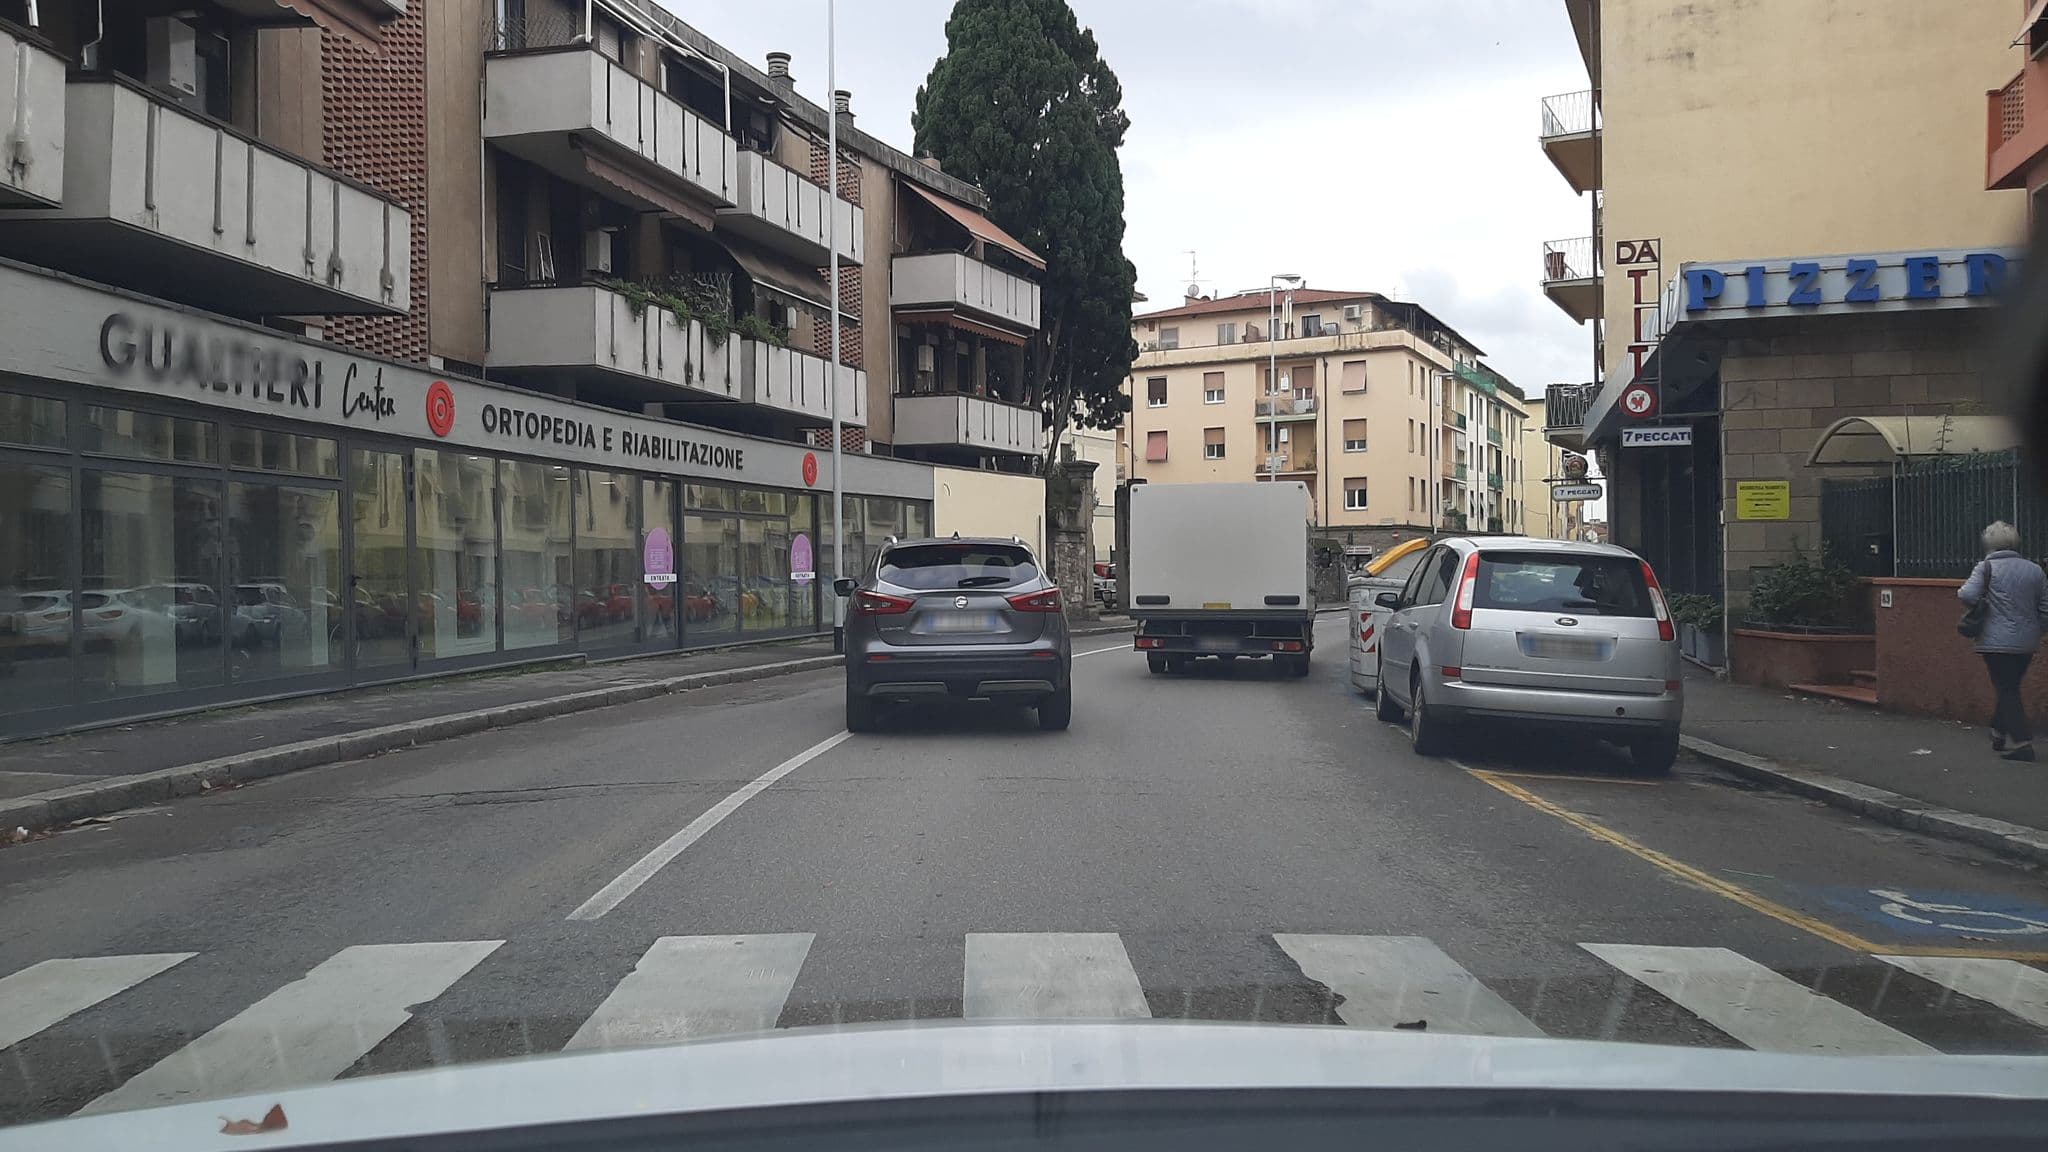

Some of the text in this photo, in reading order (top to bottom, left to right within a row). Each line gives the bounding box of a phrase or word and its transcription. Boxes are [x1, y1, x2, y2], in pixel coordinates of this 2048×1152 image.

[1616, 239, 1658, 264] DA
[342, 362, 396, 420] Center
[481, 403, 744, 470] ORTOPEDIA E RIABILITAZIONE
[1623, 431, 1691, 442] 7 PECCATI
[1567, 488, 1599, 496] PECCATI
